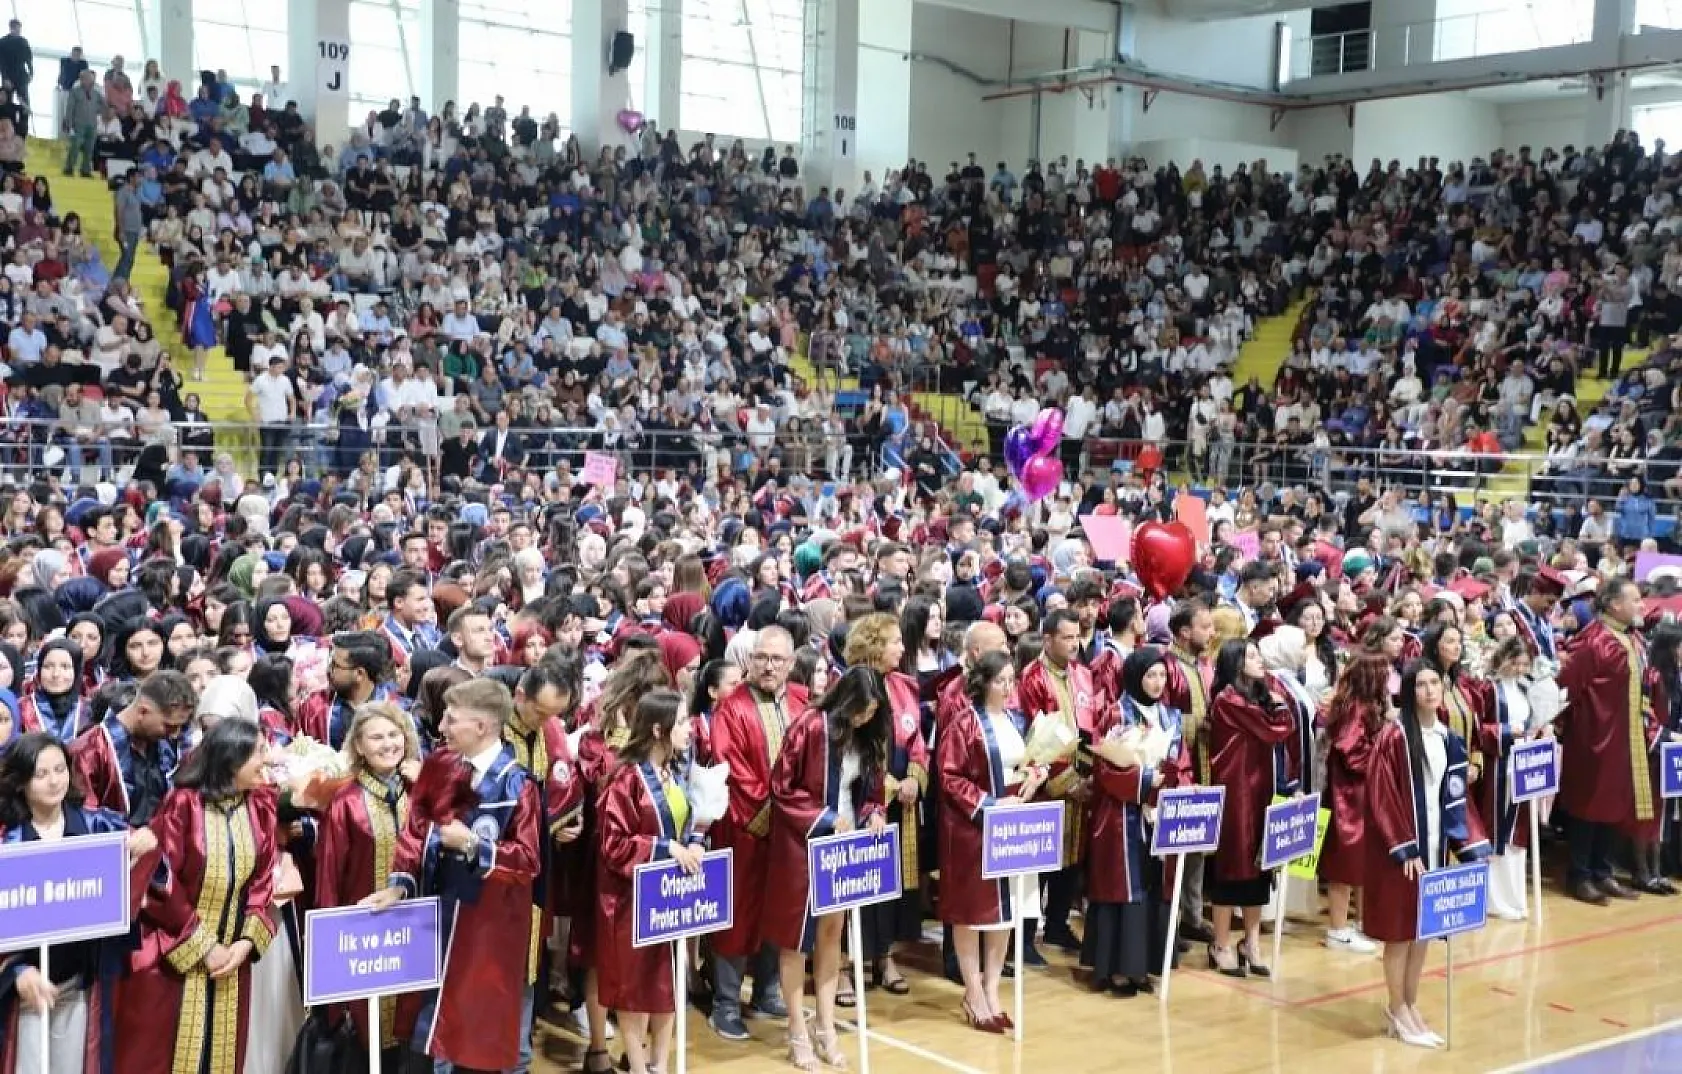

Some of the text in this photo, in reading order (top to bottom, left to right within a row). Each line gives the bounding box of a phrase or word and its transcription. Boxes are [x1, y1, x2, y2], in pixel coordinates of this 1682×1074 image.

[317, 40, 349, 61] 109
[326, 71, 341, 91] J
[834, 114, 856, 131] 108
[820, 841, 889, 874] Sağlık Kurumları
[43, 876, 103, 904] Bakımı
[649, 906, 679, 933] Protez
[694, 898, 719, 923] Ortez
[339, 926, 413, 953] İlk ve Acil
[349, 954, 402, 976] Yardım
